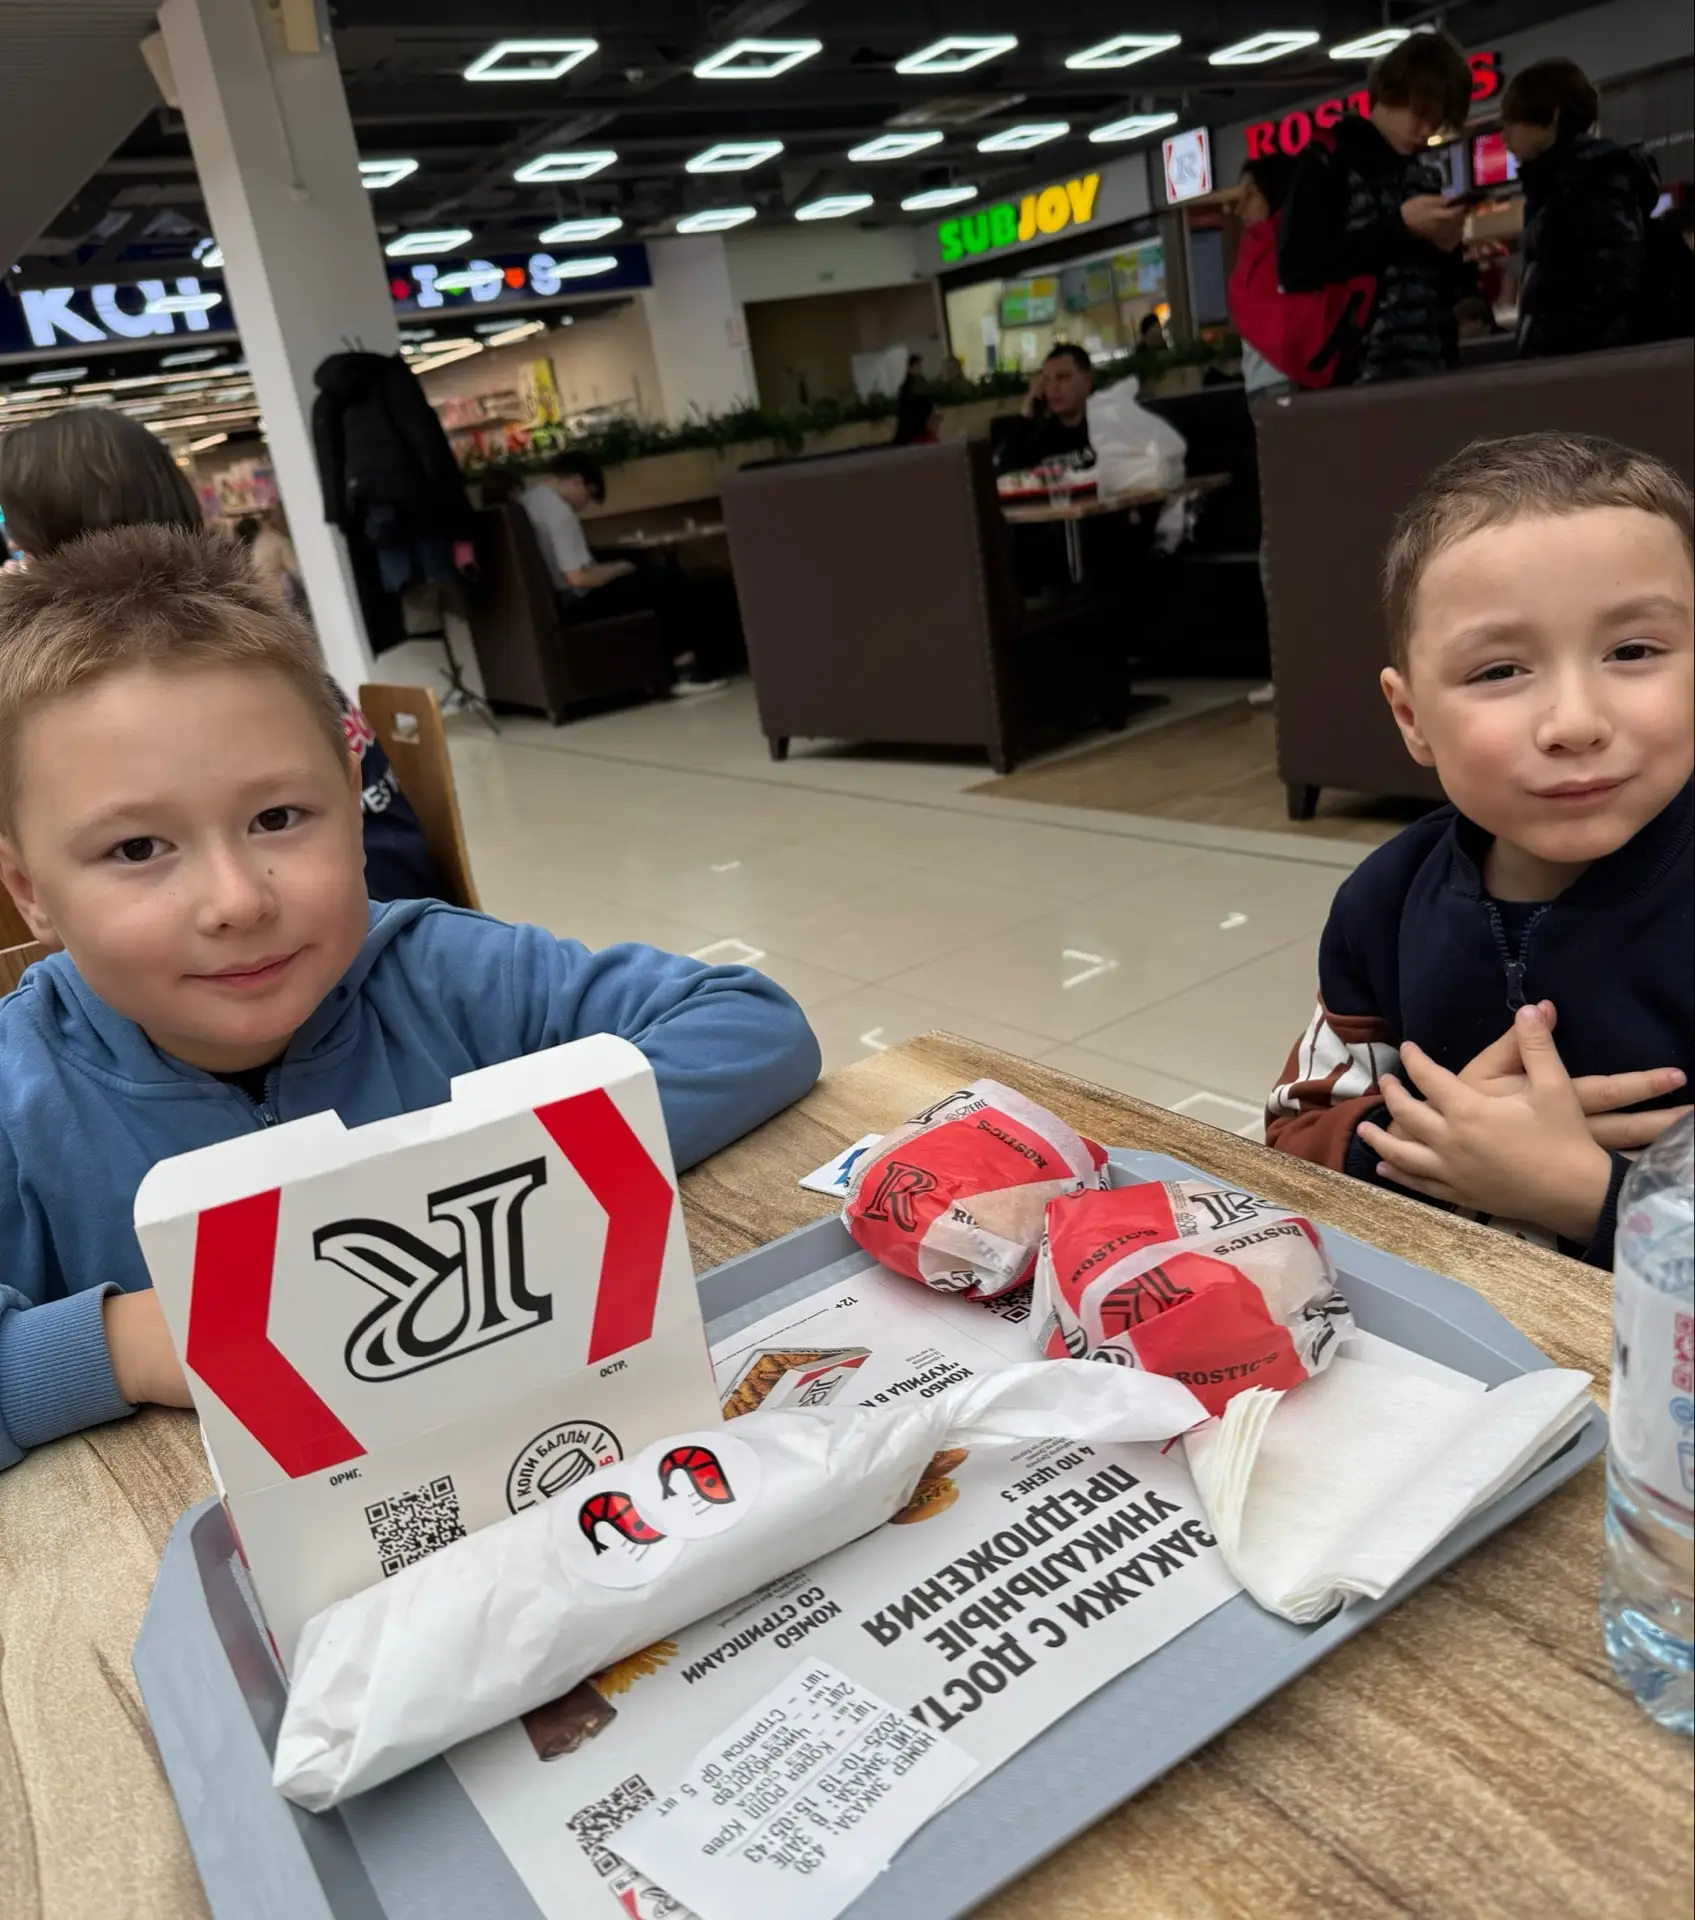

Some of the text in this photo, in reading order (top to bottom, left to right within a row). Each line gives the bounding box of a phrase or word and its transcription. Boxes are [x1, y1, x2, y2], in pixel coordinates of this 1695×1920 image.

[937, 173, 1100, 263] SUBJOY
[1213, 1224, 1302, 1256] ROSTIC'S
[835, 1296, 858, 1309] 12+
[600, 1360, 628, 1378] ОСТР.
[920, 1368, 974, 1398] КОМБО
[1174, 1352, 1278, 1387] ROSTIC'S
[517, 1430, 591, 1497] КОПИ БАЛЛЫ
[1056, 1452, 1084, 1470] ПО
[1078, 1446, 1095, 1456] 4
[329, 1467, 363, 1487] ОРИГ.
[1012, 1466, 1060, 1495] ЦЕНЕ
[1000, 1490, 1018, 1503] 3
[860, 1464, 1140, 1647] ПРЕДЛОЖЕНИЯ
[923, 1490, 1183, 1662] УНИКАЛЬНЫЕ
[1056, 1519, 1218, 1629] ЗАКАЖИ
[796, 1586, 825, 1608] СО
[774, 1601, 842, 1649] КОМБО
[1027, 1617, 1067, 1648] С
[681, 1604, 798, 1684] СТРИПСАМИ
[886, 1717, 921, 1751] ТИП
[700, 1763, 723, 1783] ОР
[784, 1740, 836, 1782] Корея
[680, 1784, 698, 1797] 5
[743, 1712, 903, 1863] 2025-10-19 15:05:43
[826, 1751, 890, 1809] ЗАКАЗА:
[656, 1797, 679, 1817] шт
[793, 1732, 938, 1875] НОМЕР ЗАКАЗА: 430
[809, 1811, 829, 1827] В
